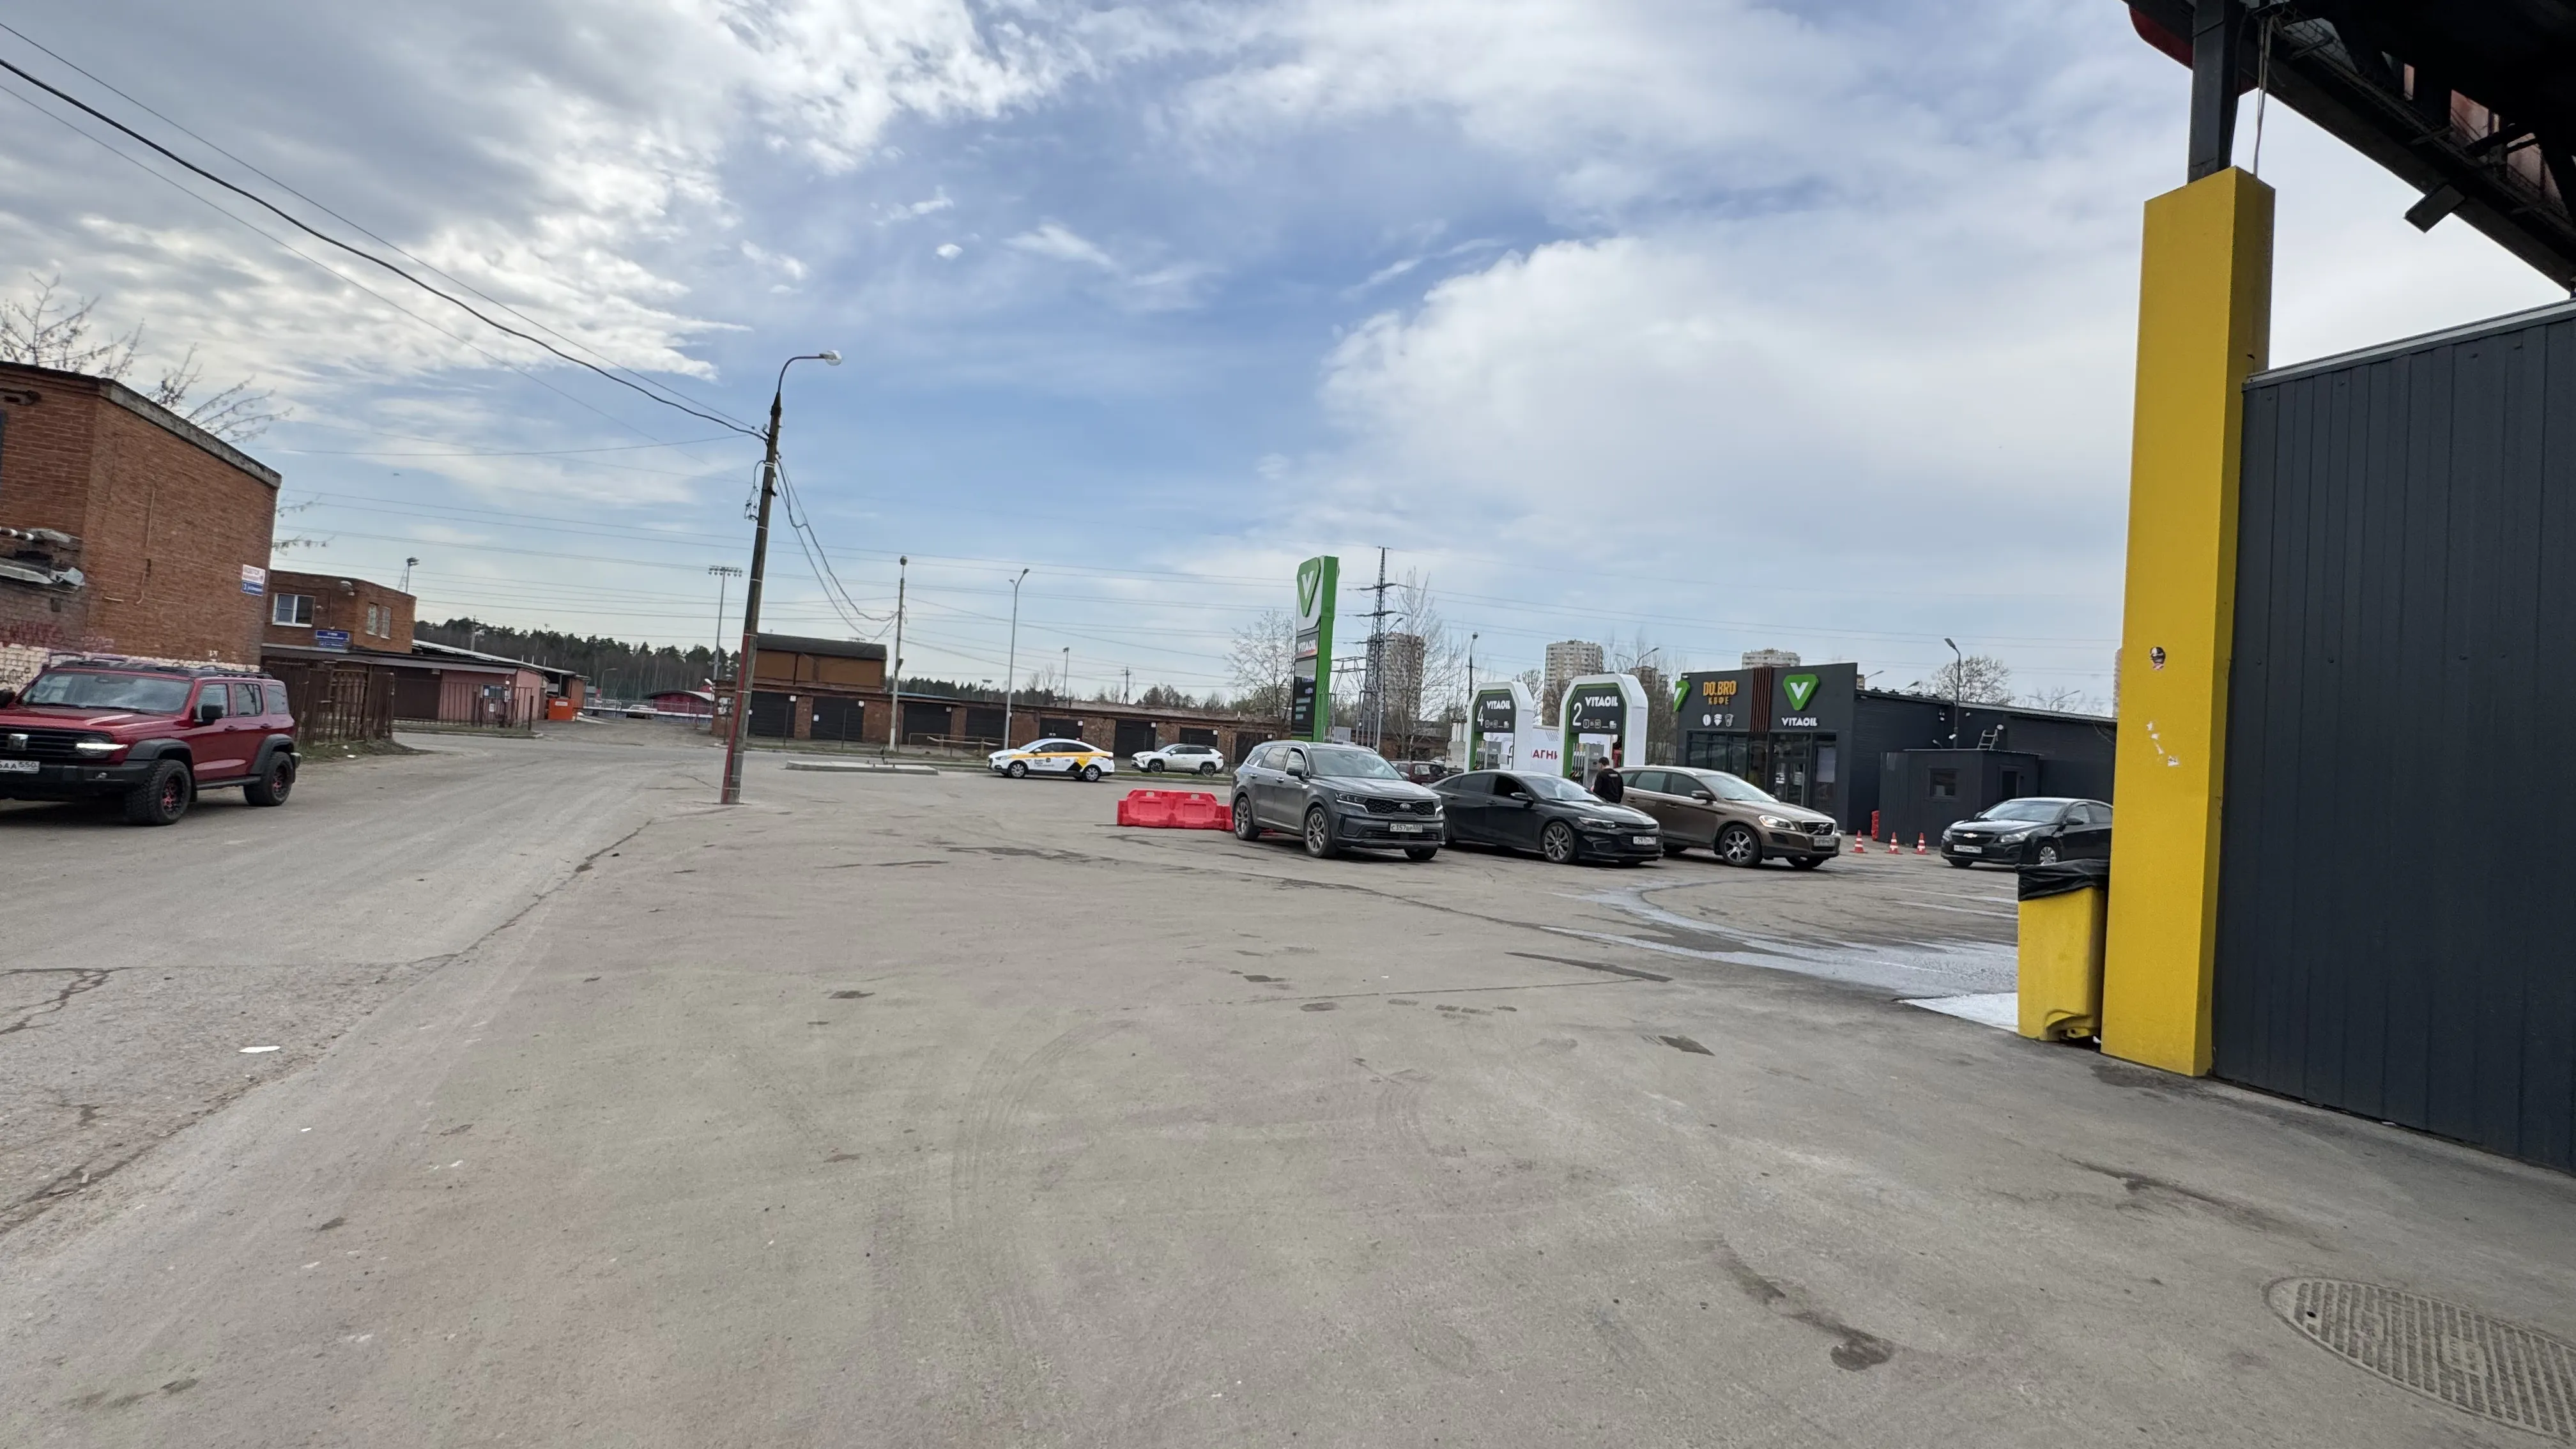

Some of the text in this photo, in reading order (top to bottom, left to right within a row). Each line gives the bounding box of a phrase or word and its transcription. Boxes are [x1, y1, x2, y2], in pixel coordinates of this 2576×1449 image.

[1703, 680, 1736, 696] DO.BRO
[1486, 700, 1511, 710] VITAOIL
[1584, 696, 1618, 707] VITAOIL
[1477, 705, 1484, 726] 4
[1572, 702, 1583, 726] 2
[1781, 716, 1818, 727] VITAOIL
